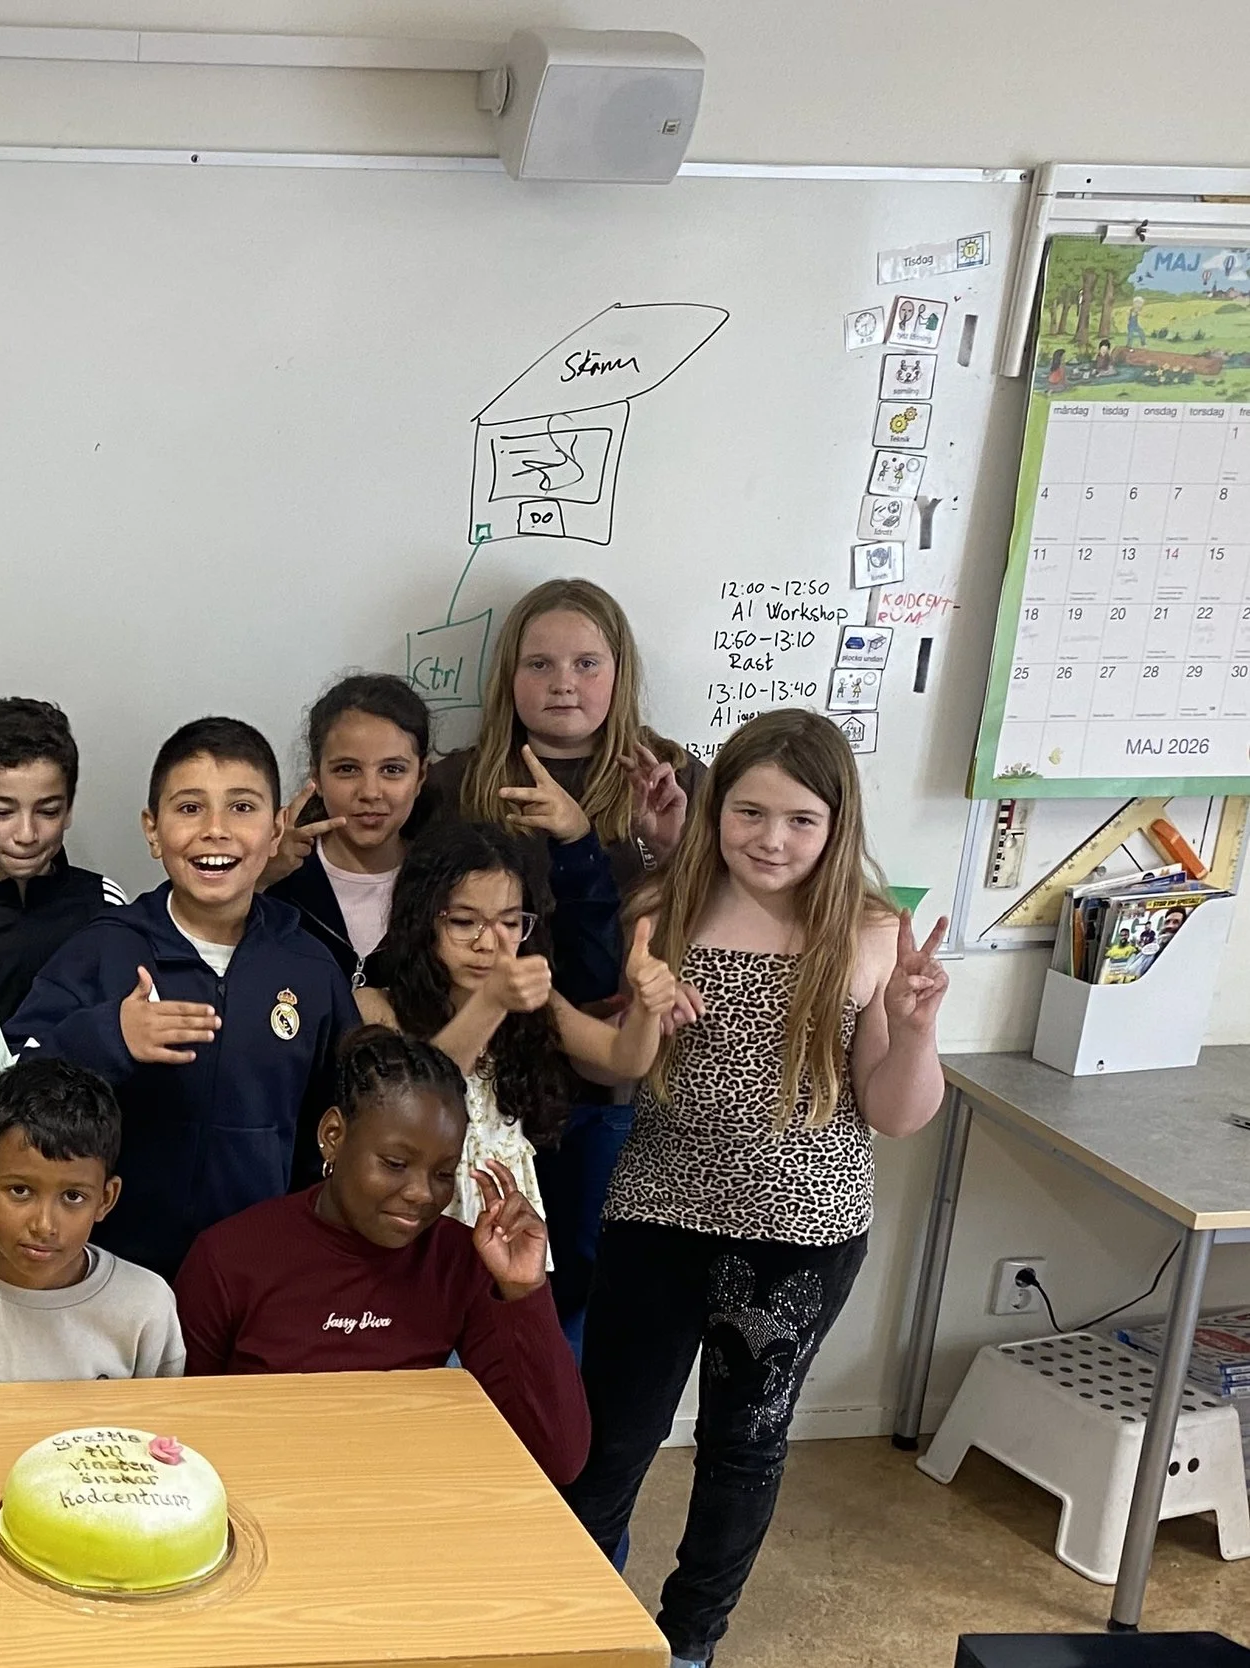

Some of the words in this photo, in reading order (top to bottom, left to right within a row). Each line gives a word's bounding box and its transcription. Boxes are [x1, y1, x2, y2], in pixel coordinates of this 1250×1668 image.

[903, 255, 934, 267] Tisdag
[1154, 252, 1201, 272] MAJ
[1053, 405, 1090, 417] måndag
[1102, 405, 1130, 417] tisdag
[1143, 405, 1178, 418] onsdag
[1189, 406, 1225, 418] torsdag
[1232, 427, 1239, 440] 1
[1040, 488, 1049, 500] 4
[1085, 487, 1094, 500] 5
[1129, 487, 1138, 500] 6
[1174, 487, 1182, 500] 7
[1219, 487, 1228, 500] 8
[1033, 548, 1047, 561] 11
[1078, 548, 1092, 561] 12
[1121, 548, 1136, 561] 13
[1165, 548, 1179, 560] 14
[1210, 548, 1225, 560] 15
[766, 602, 848, 625] Workshop
[1024, 608, 1039, 620] 18
[1067, 608, 1082, 620] 19
[1110, 608, 1126, 620] 20
[1154, 608, 1169, 620] 21
[1197, 607, 1213, 619] 22
[1243, 607, 1250, 619] 2
[729, 653, 774, 671] Rast
[413, 657, 463, 693] Ctrl
[1014, 667, 1029, 679] 25
[1056, 667, 1072, 679] 26
[1100, 667, 1116, 679] 27
[1143, 666, 1159, 678] 28
[1186, 665, 1202, 677] 29
[1231, 665, 1248, 677] 30
[1126, 739, 1163, 754] MAJ
[1168, 739, 1209, 753] 2026
[322, 1312, 358, 1334] Sassy
[359, 1311, 392, 1329] Diva
